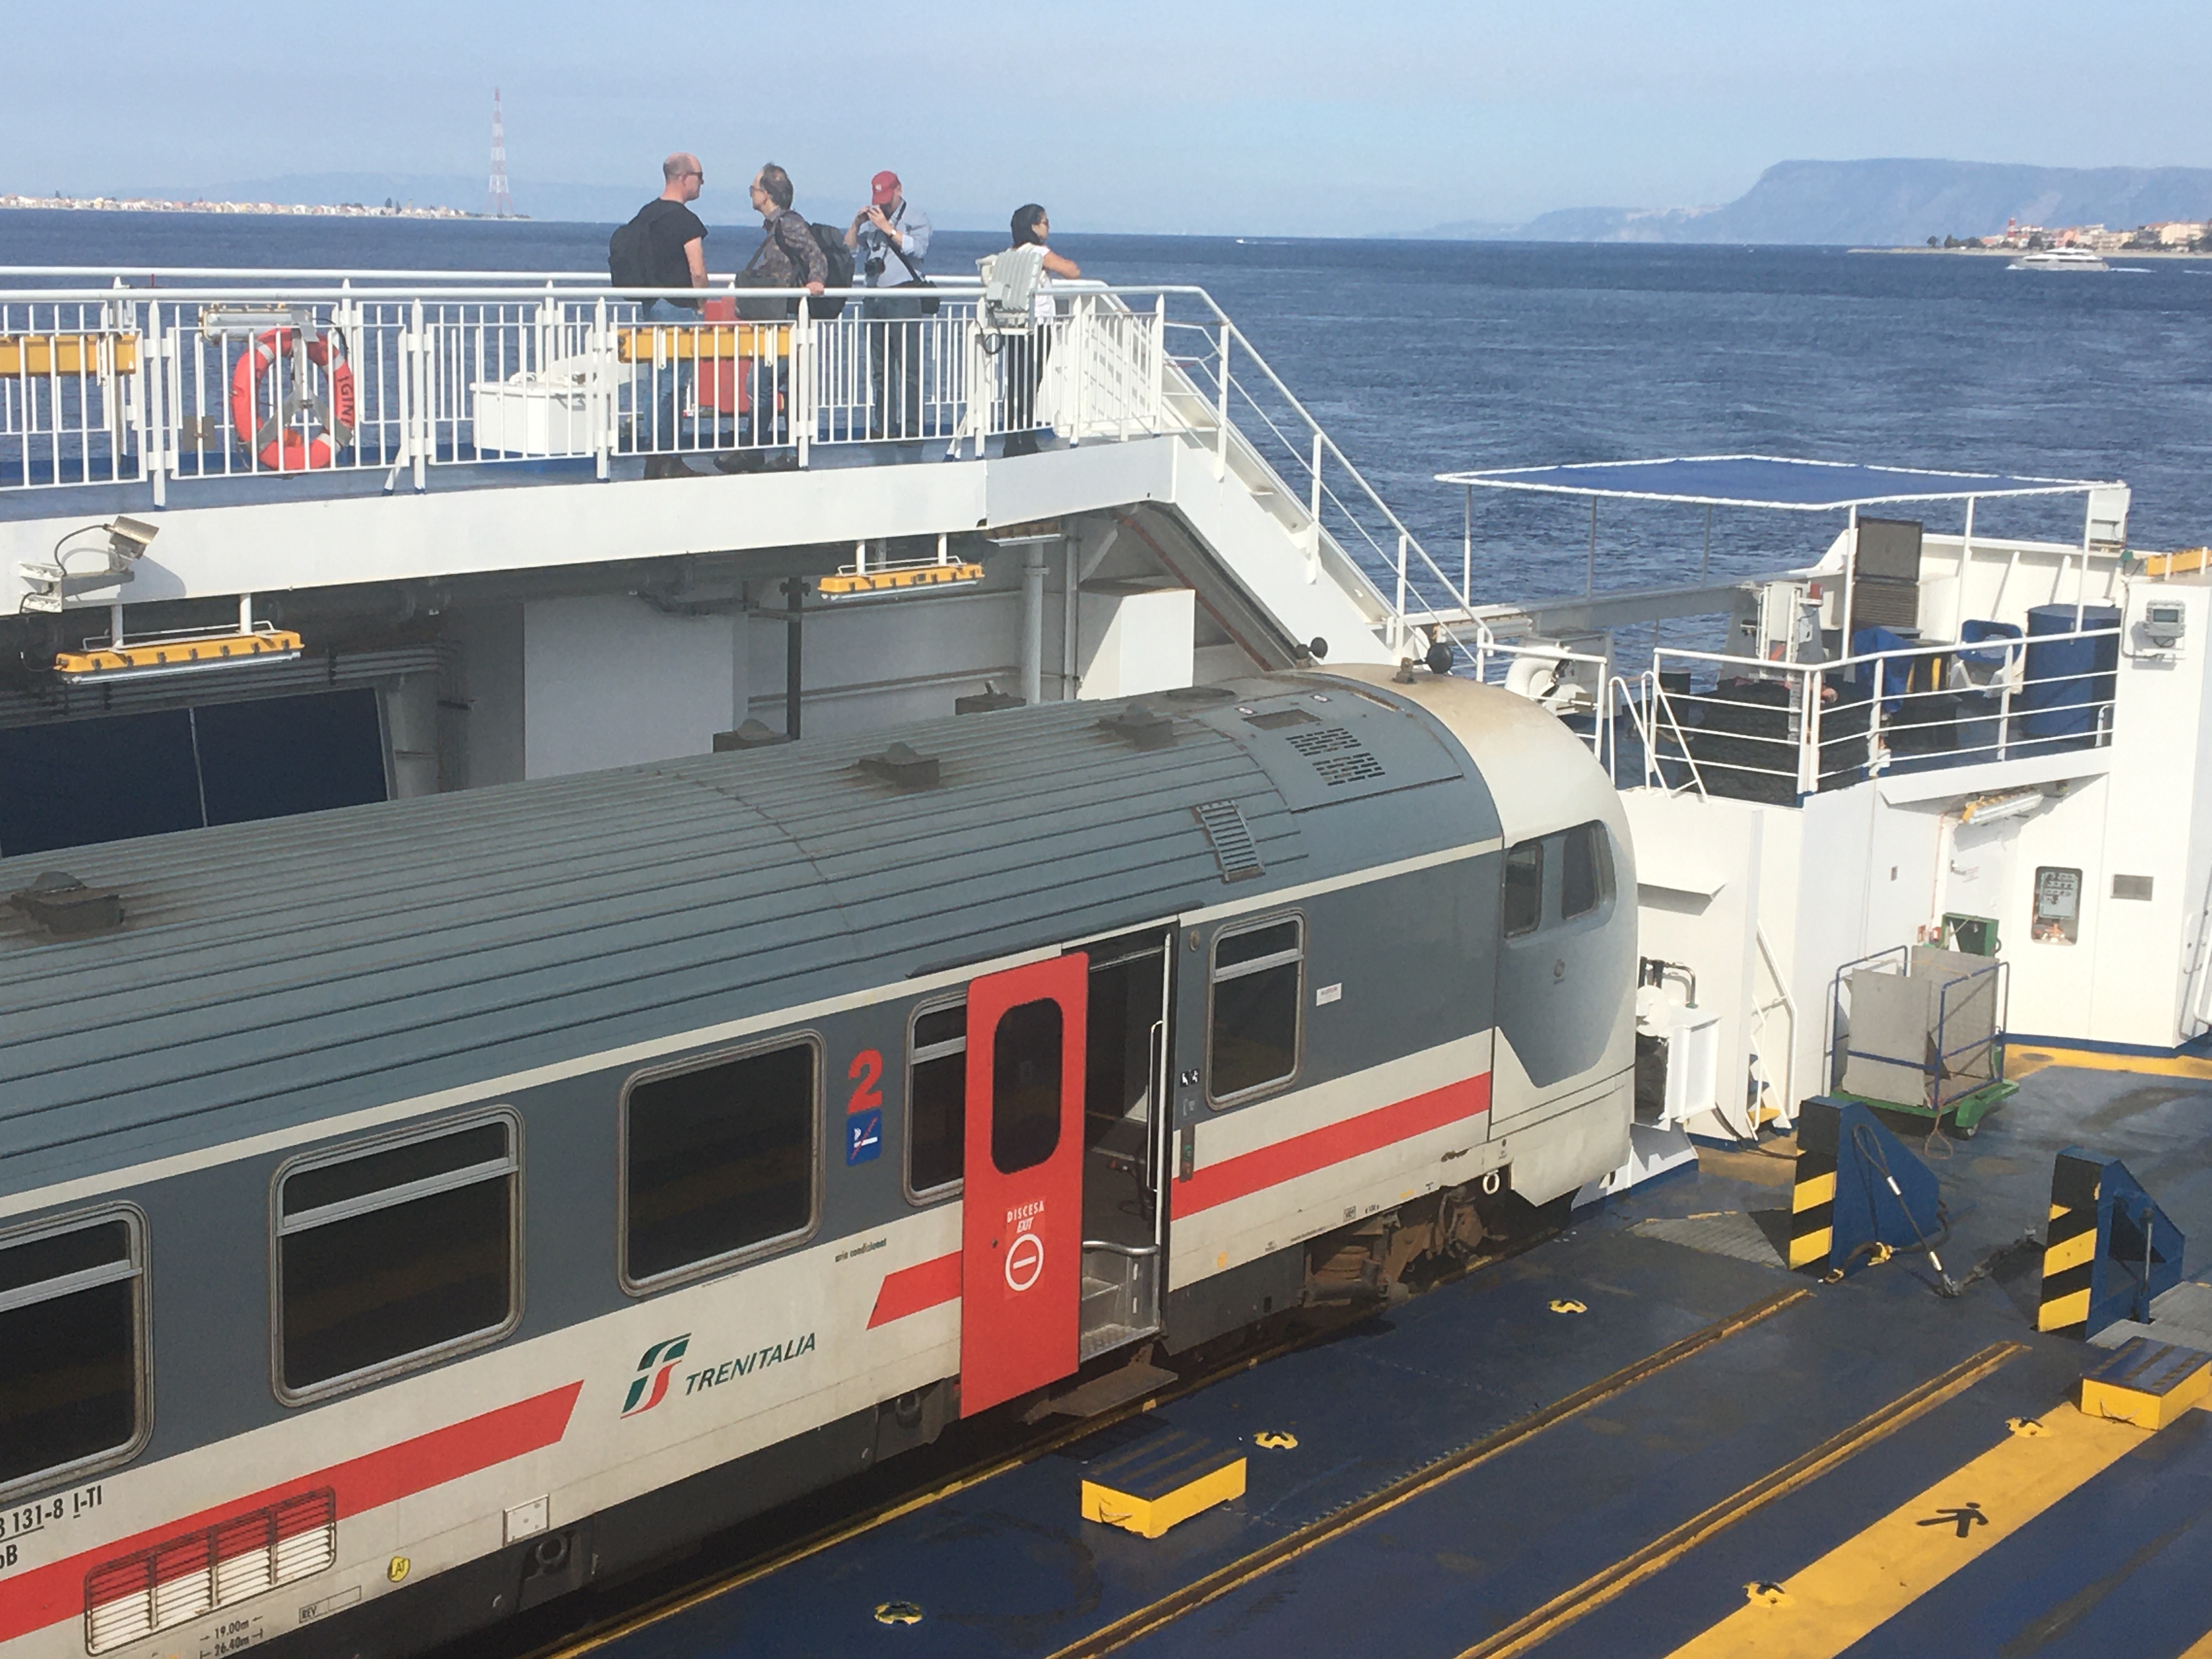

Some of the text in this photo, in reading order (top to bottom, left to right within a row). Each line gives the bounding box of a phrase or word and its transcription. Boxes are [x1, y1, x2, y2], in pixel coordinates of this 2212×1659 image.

[337, 376, 354, 425] IGINI
[847, 1047, 883, 1115] 2
[1007, 1200, 1044, 1223] DISCESA
[685, 1332, 816, 1396] TRENITALIA
[13, 1498, 64, 1533] 131-8
[215, 1620, 249, 1639] 19.00m
